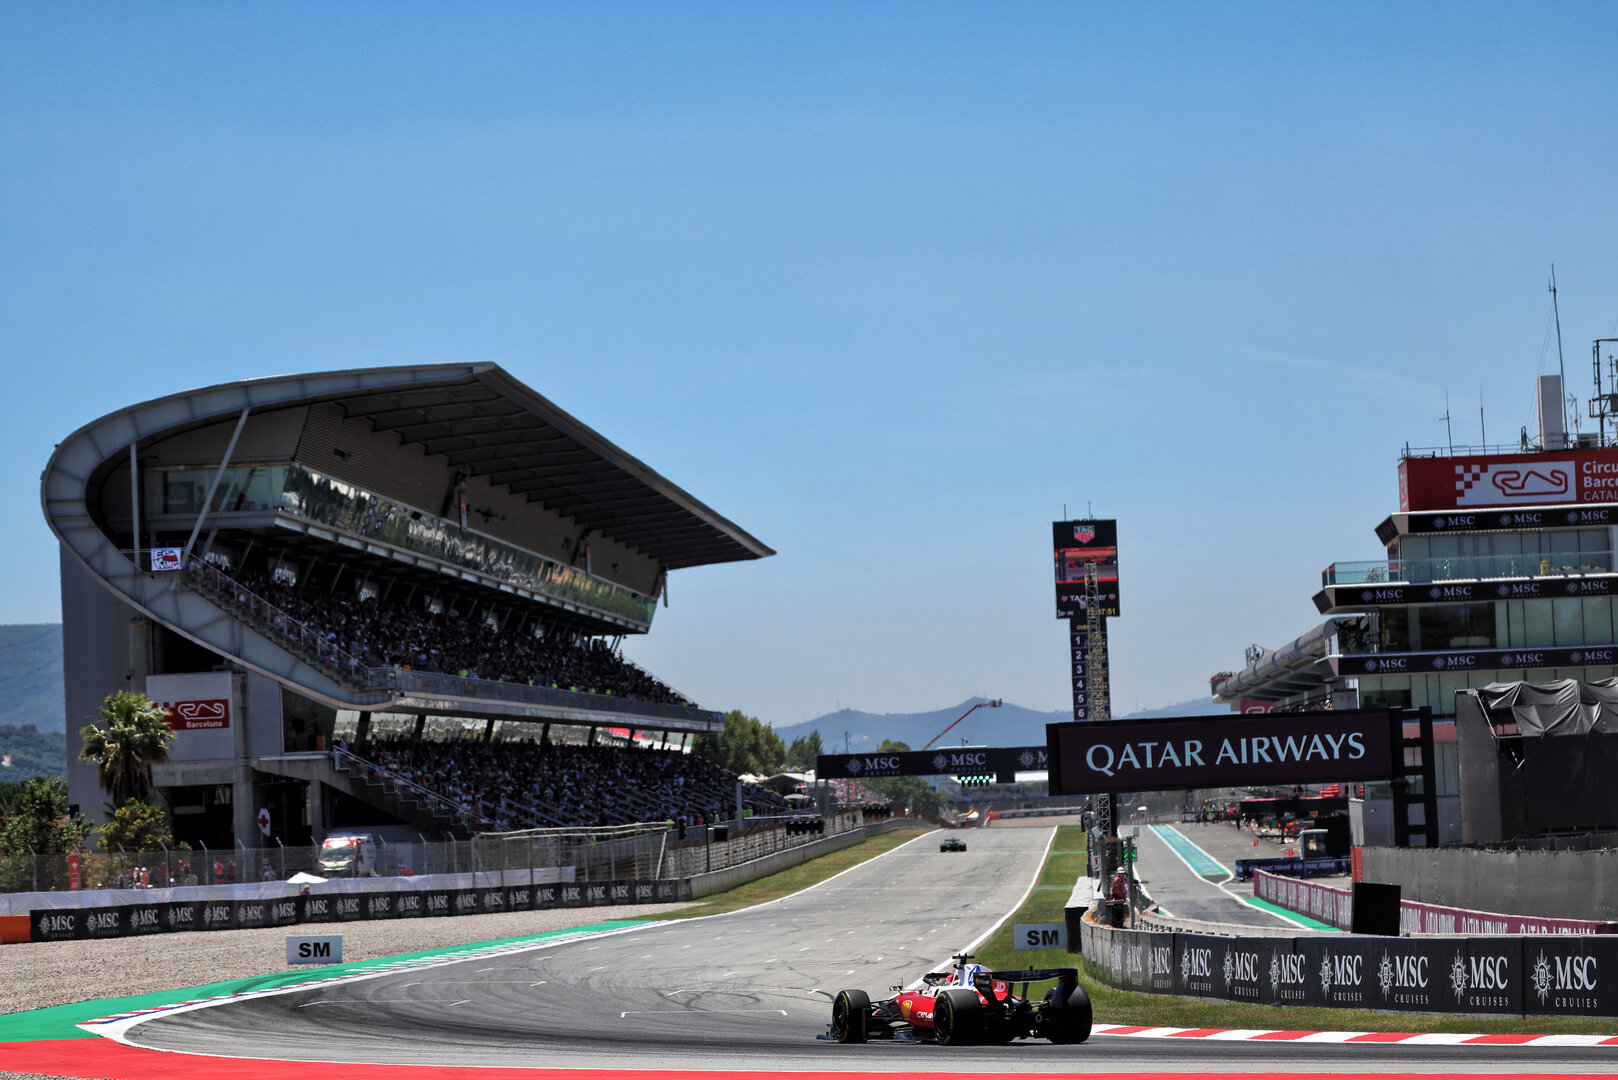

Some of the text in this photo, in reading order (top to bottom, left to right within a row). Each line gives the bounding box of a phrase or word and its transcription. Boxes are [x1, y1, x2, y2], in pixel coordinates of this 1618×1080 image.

[1447, 516, 1475, 526] MSC
[1514, 513, 1542, 523] MSC
[1581, 510, 1608, 520] MSC
[1444, 586, 1472, 596] MSC
[1512, 583, 1540, 593] MSC
[1581, 581, 1609, 590] MSC
[1375, 589, 1403, 599] MSC
[1075, 635, 1081, 645] 1
[1075, 650, 1082, 660] 2
[1447, 656, 1475, 666] MSC
[1516, 653, 1543, 663] MSC
[1584, 650, 1612, 660] MSC
[1380, 658, 1407, 668] MSC
[1076, 665, 1083, 674] 3
[1077, 680, 1083, 689] 4
[1077, 694, 1084, 703] 5
[1078, 708, 1085, 718] 6
[951, 753, 986, 766] MSC
[1086, 740, 1206, 777] QATAR
[1215, 732, 1366, 765] AIRWAYS
[864, 757, 900, 770] MSC
[279, 902, 296, 917] MSC
[312, 899, 328, 914] MSC
[375, 897, 391, 911] MSC
[140, 909, 159, 925] MSC
[176, 906, 194, 922] MSC
[212, 906, 230, 921] MSC
[247, 905, 264, 920] MSC
[51, 915, 75, 931] MSC
[98, 912, 119, 928] MSC
[1027, 930, 1059, 946] SM
[298, 942, 331, 958] SM
[1154, 947, 1171, 975] MSC
[1191, 948, 1212, 977] MSC
[1234, 951, 1258, 982] MSC
[1280, 954, 1305, 984] MSC
[1334, 955, 1362, 986] MSC
[1395, 955, 1428, 988] MSC
[1470, 956, 1508, 990] MSC
[1554, 955, 1597, 991] MSC
[1234, 986, 1259, 997] CRUISES
[1280, 990, 1305, 1000] CRUISES
[1333, 992, 1362, 1001] CRUISES
[1394, 994, 1429, 1004] CRUISES
[1469, 996, 1509, 1006] CRUISES
